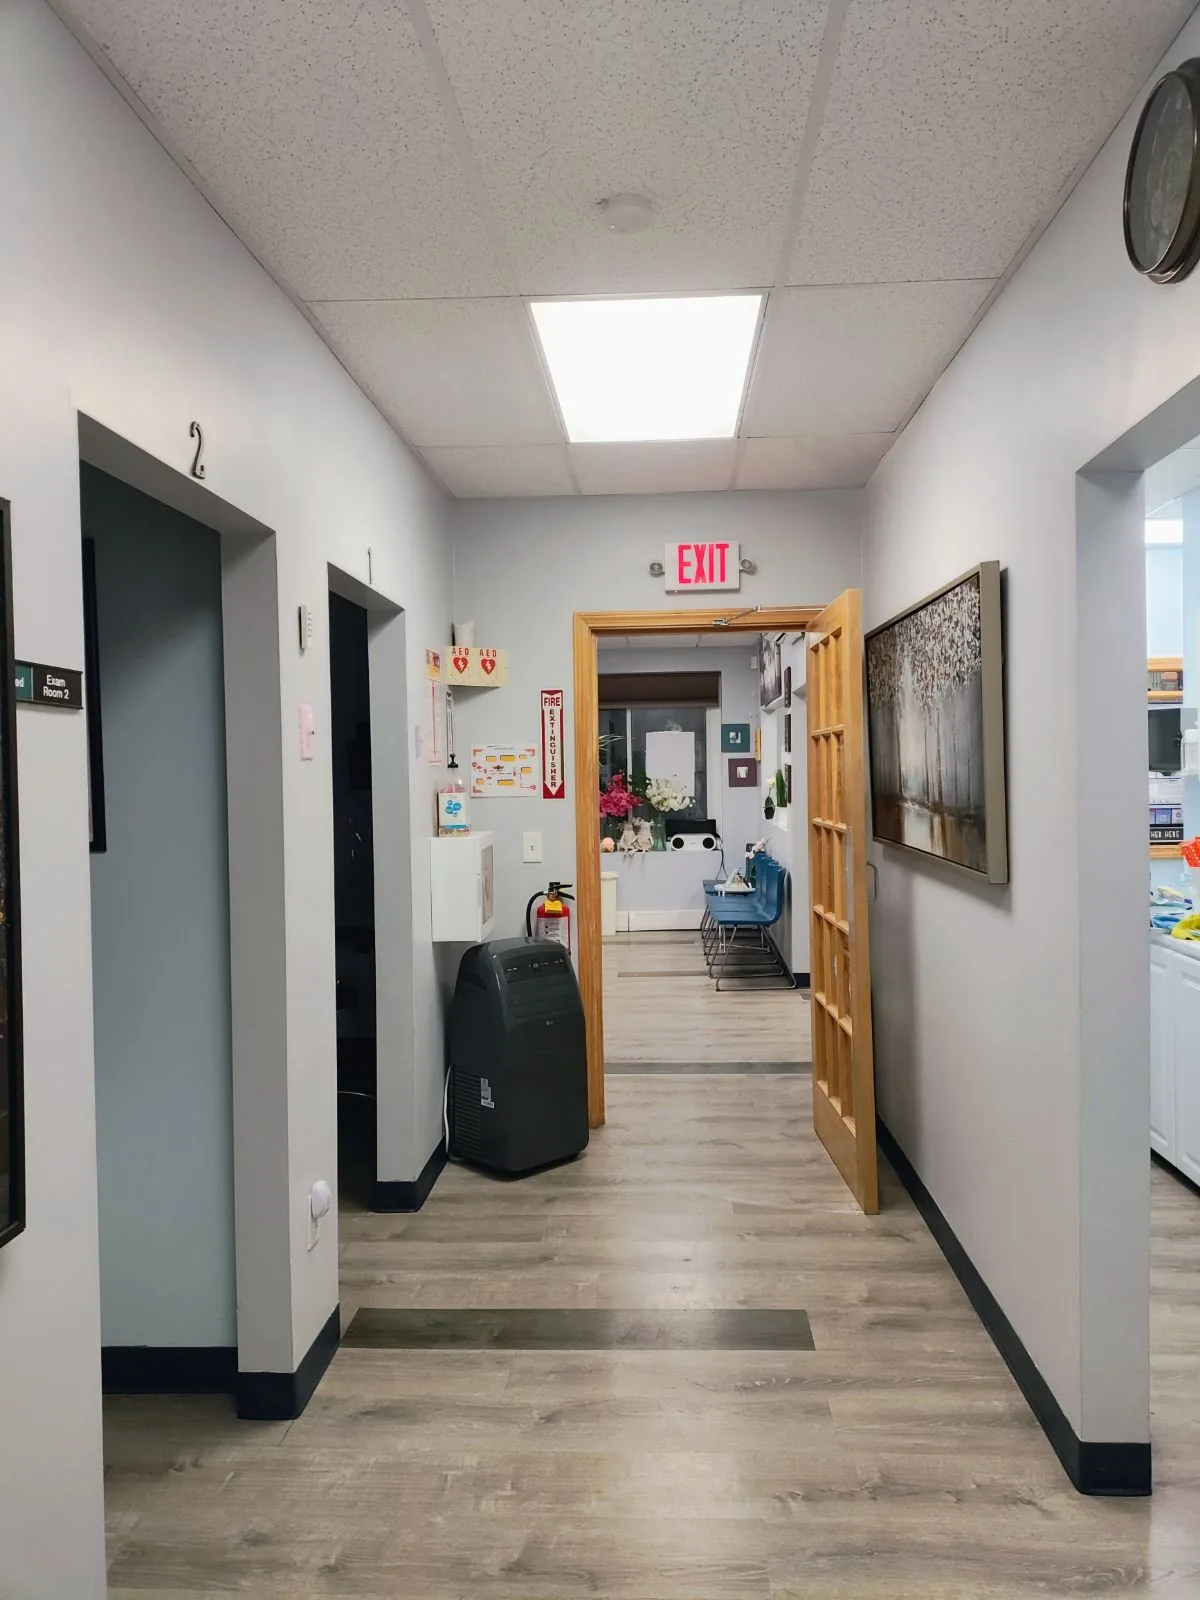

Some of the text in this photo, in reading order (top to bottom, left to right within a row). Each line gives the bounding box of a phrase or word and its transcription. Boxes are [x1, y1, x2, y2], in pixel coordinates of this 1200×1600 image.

[189, 420, 206, 480] 2
[678, 543, 730, 584] EXIT
[452, 647, 470, 656] AED
[479, 649, 497, 658] AED
[46, 674, 66, 687] Exam
[43, 685, 70, 700] Room 2
[543, 696, 561, 707] FIRE
[549, 708, 557, 788] EXTINGUISHER
